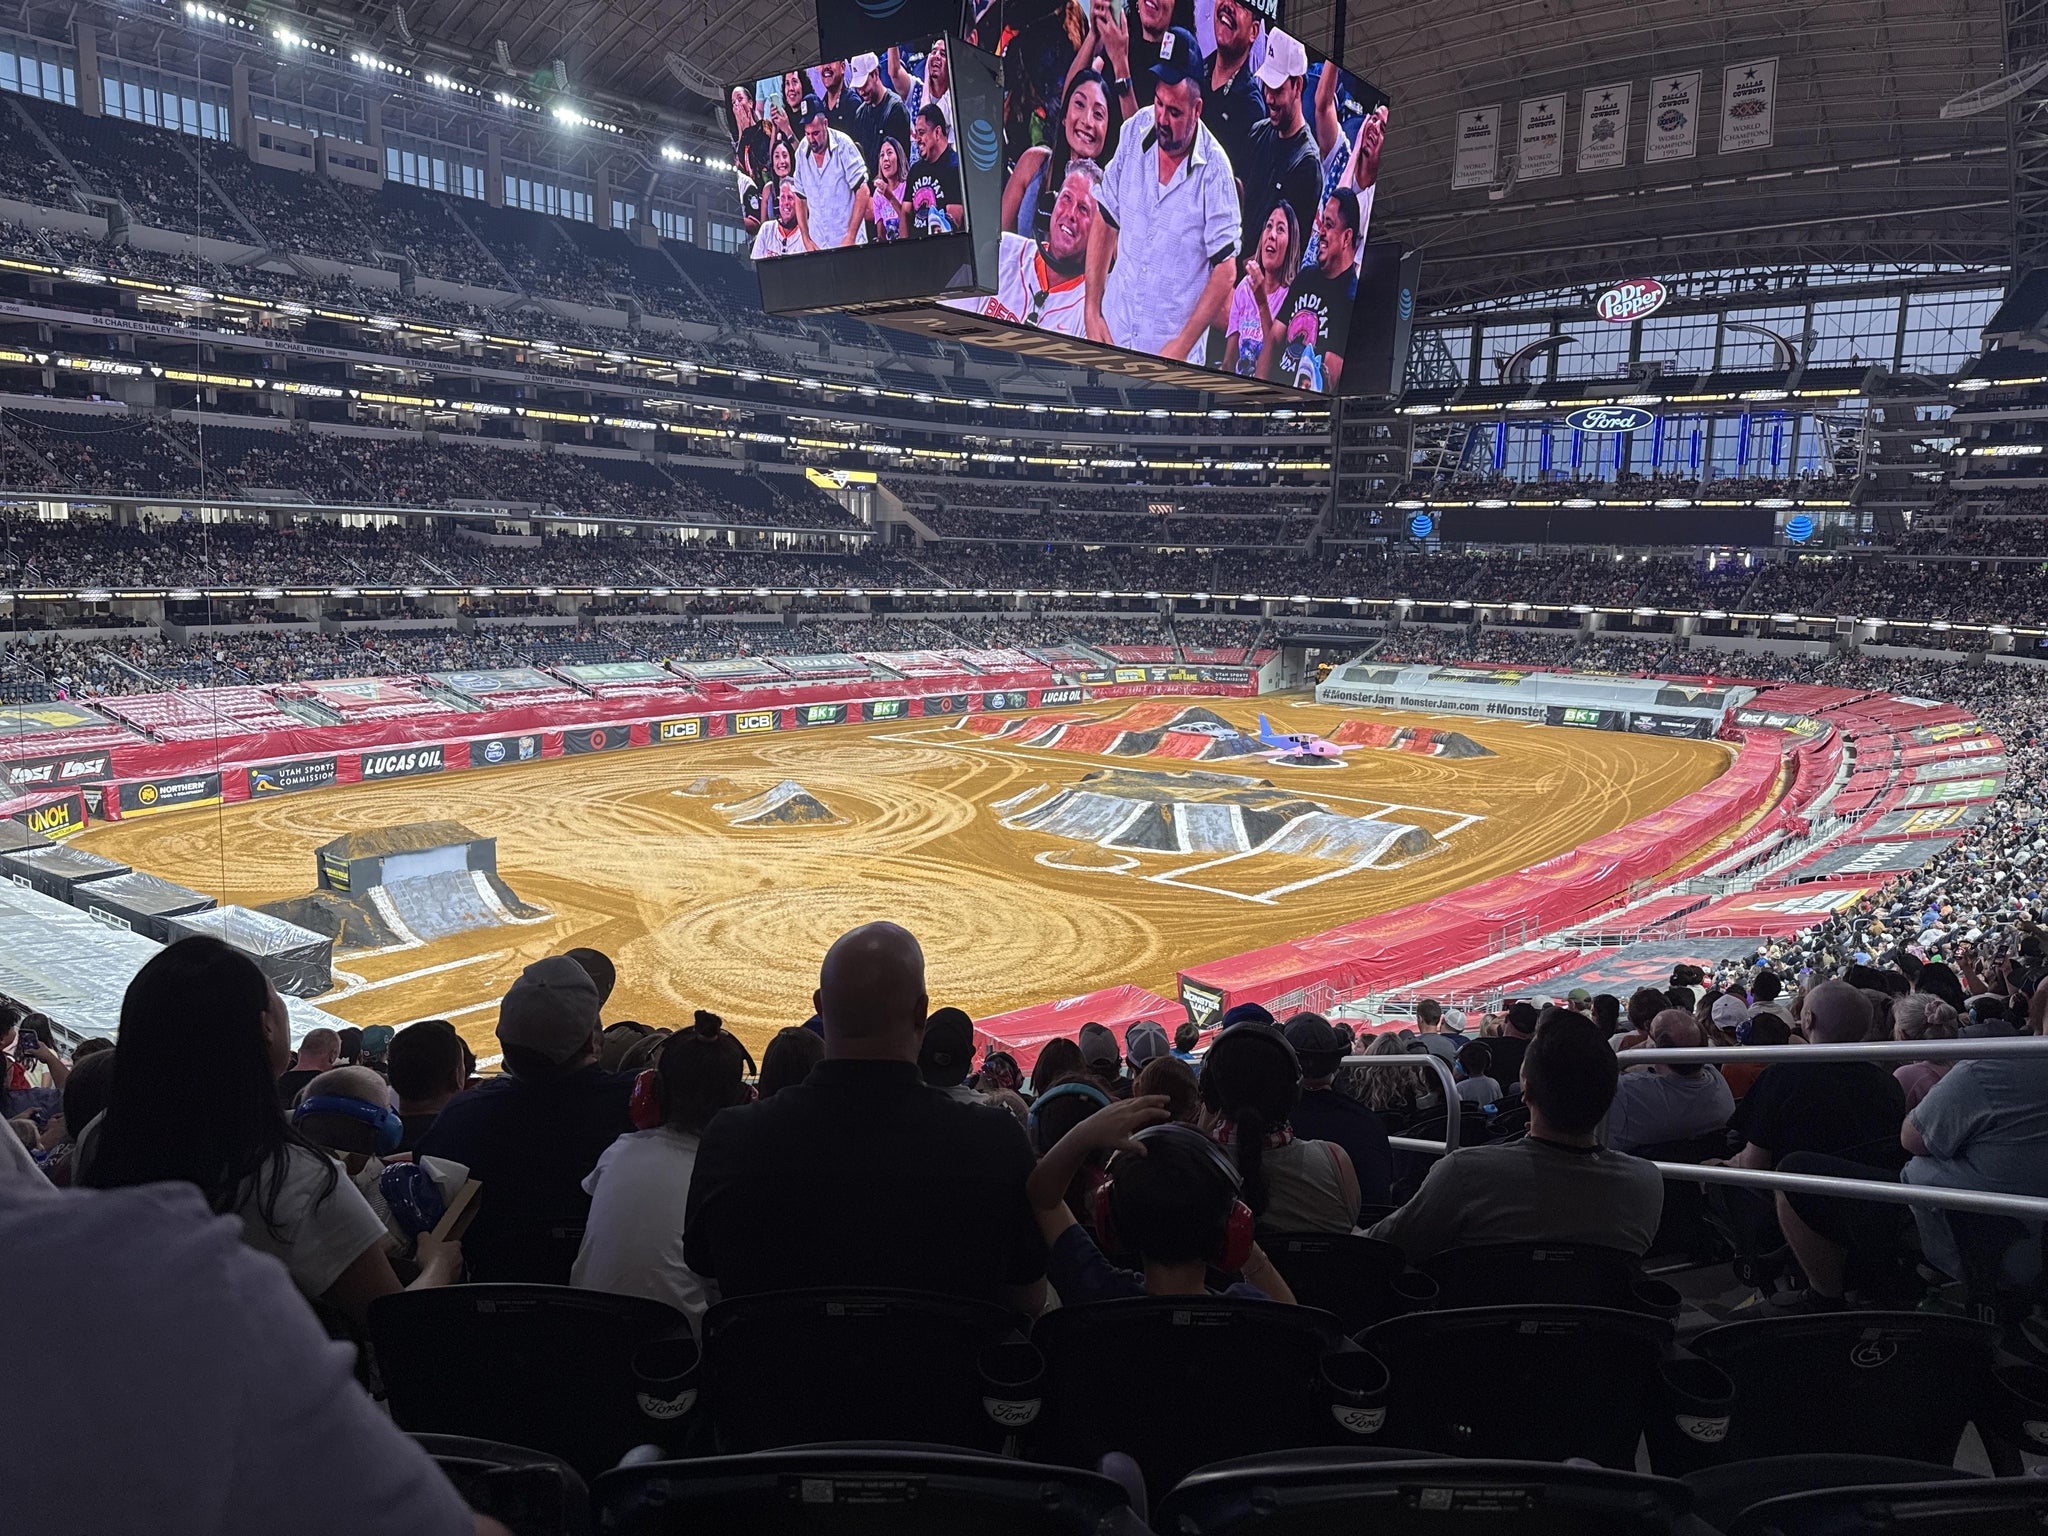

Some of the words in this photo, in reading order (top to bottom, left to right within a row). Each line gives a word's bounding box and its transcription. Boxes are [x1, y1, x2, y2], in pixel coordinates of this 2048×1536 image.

[1736, 80, 1763, 90] DALLAS
[1662, 92, 1688, 101] DALLAS
[1732, 87, 1766, 98] COWBOYS
[1594, 103, 1618, 112] DALLAS
[1658, 98, 1690, 108] COWBOYS
[1530, 114, 1553, 122] DALLAS
[1590, 109, 1620, 118] COWBOYS
[1467, 124, 1489, 132] DALLAS
[1527, 120, 1556, 129] COWBOYS
[1733, 123, 1761, 132] WORLD
[1463, 130, 1491, 139] COWBOYS
[1658, 133, 1685, 142] WORLD
[1724, 129, 1769, 142] CHAMPIONS
[1590, 143, 1615, 152] WORLD
[1649, 140, 1693, 152] CHAMPIONS
[1527, 153, 1552, 161] WORLD
[1581, 151, 1622, 161] CHAMPIONS
[1519, 159, 1559, 170] CHAMPIONS
[1456, 168, 1493, 178] CHAMPIONS
[1621, 284, 1645, 302] Dr
[1605, 290, 1661, 319] Pepper
[92, 317, 104, 325] 94
[104, 318, 144, 331] CHARLES
[144, 323, 172, 334] HALEY
[274, 342, 305, 353] MICHAEL
[306, 345, 325, 355] IRVIN
[428, 362, 451, 371] AIKMAN
[1582, 410, 1637, 429] Ford
[1042, 692, 1068, 704] LUCAS
[1068, 690, 1082, 702] OIL
[1322, 688, 1395, 706] #MonsterJam
[1400, 696, 1480, 711] MonsterJam.com
[808, 705, 837, 721] BKT
[873, 701, 900, 716] BKT
[739, 715, 770, 729] JCB
[1564, 709, 1600, 723] BKT
[663, 722, 697, 738] JCB
[364, 753, 417, 775] LUCAS
[418, 750, 442, 769] OIL
[279, 769, 302, 778] UTAH
[304, 763, 335, 773] SPORTS
[279, 771, 335, 786] COMMISSION
[160, 781, 206, 795] NORTHERN
[28, 803, 69, 833] UNOH
[1182, 990, 1220, 1011] MONSTER
[1191, 1002, 1209, 1014] JAM
[645, 1396, 688, 1417] Ford
[992, 1399, 1034, 1422] Ford
